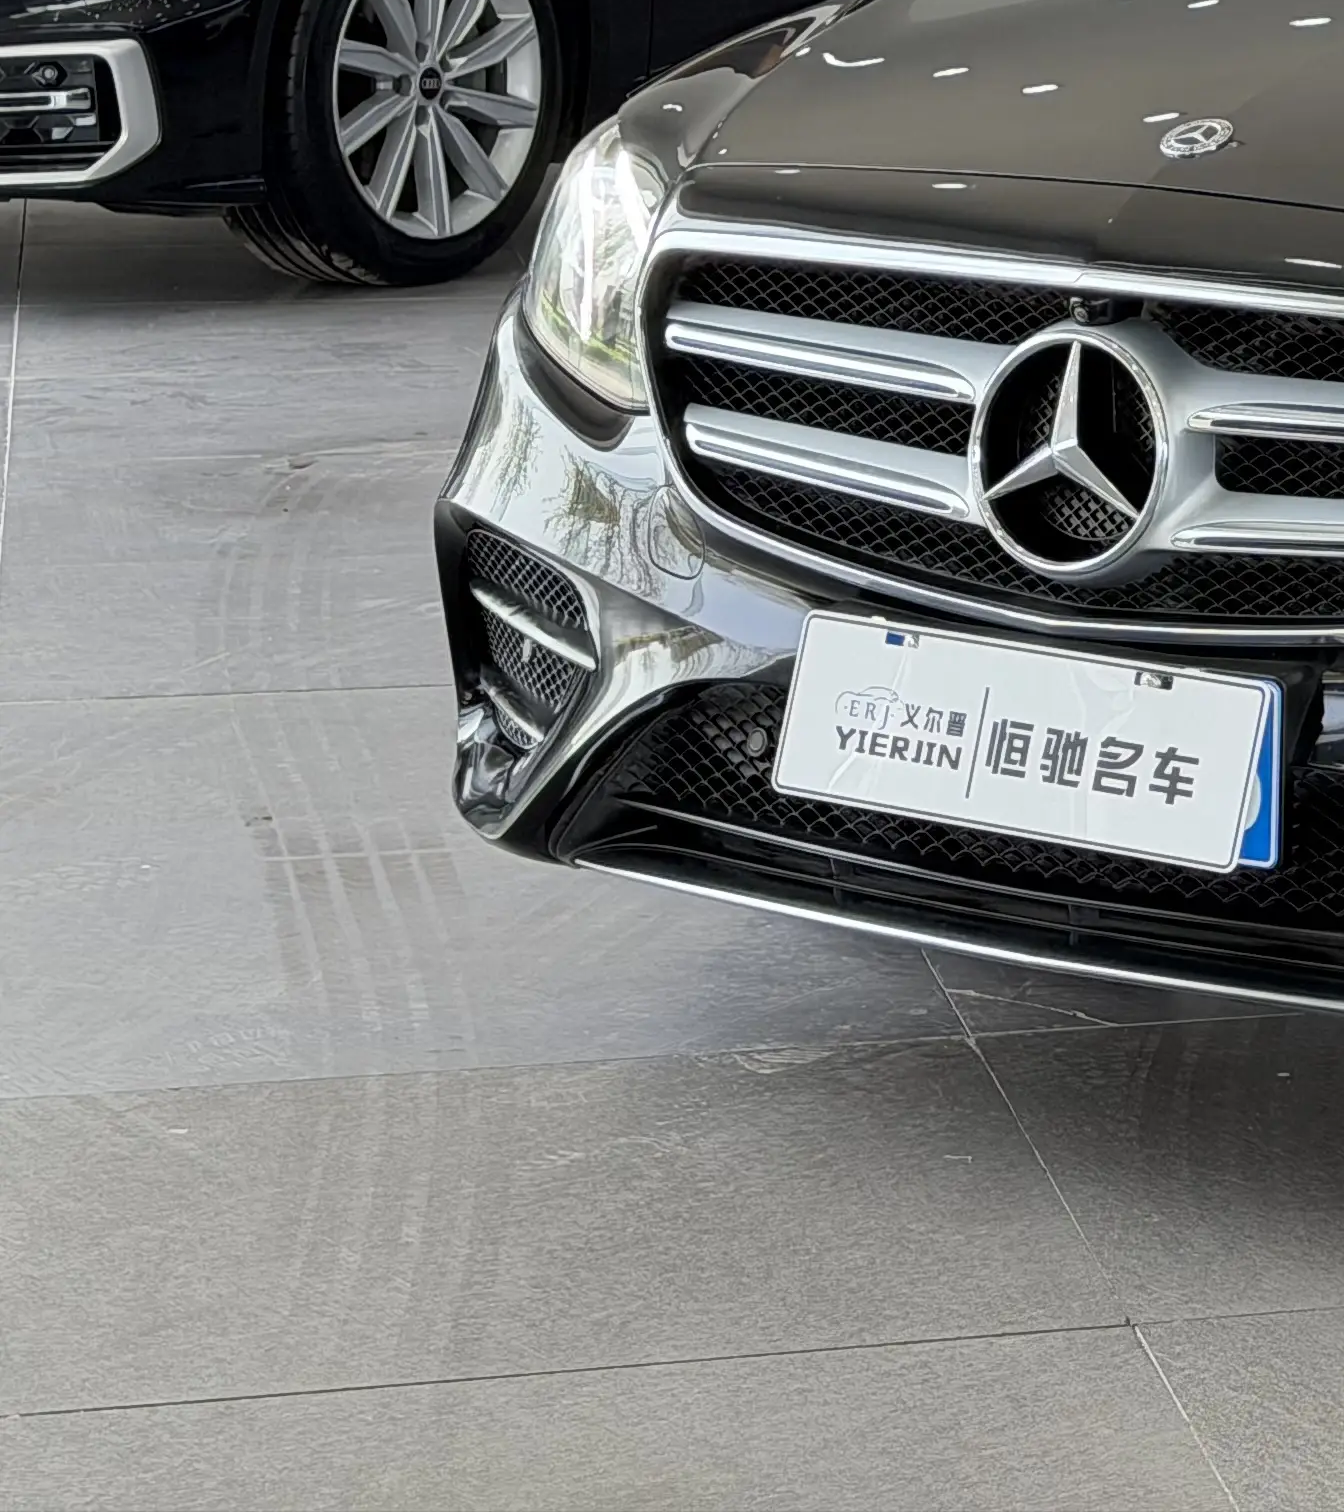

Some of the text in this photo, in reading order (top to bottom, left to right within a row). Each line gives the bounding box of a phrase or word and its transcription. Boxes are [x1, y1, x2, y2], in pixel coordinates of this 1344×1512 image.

[835, 725, 963, 771] YIERJIN
[985, 718, 1200, 805] 恒驰名车
